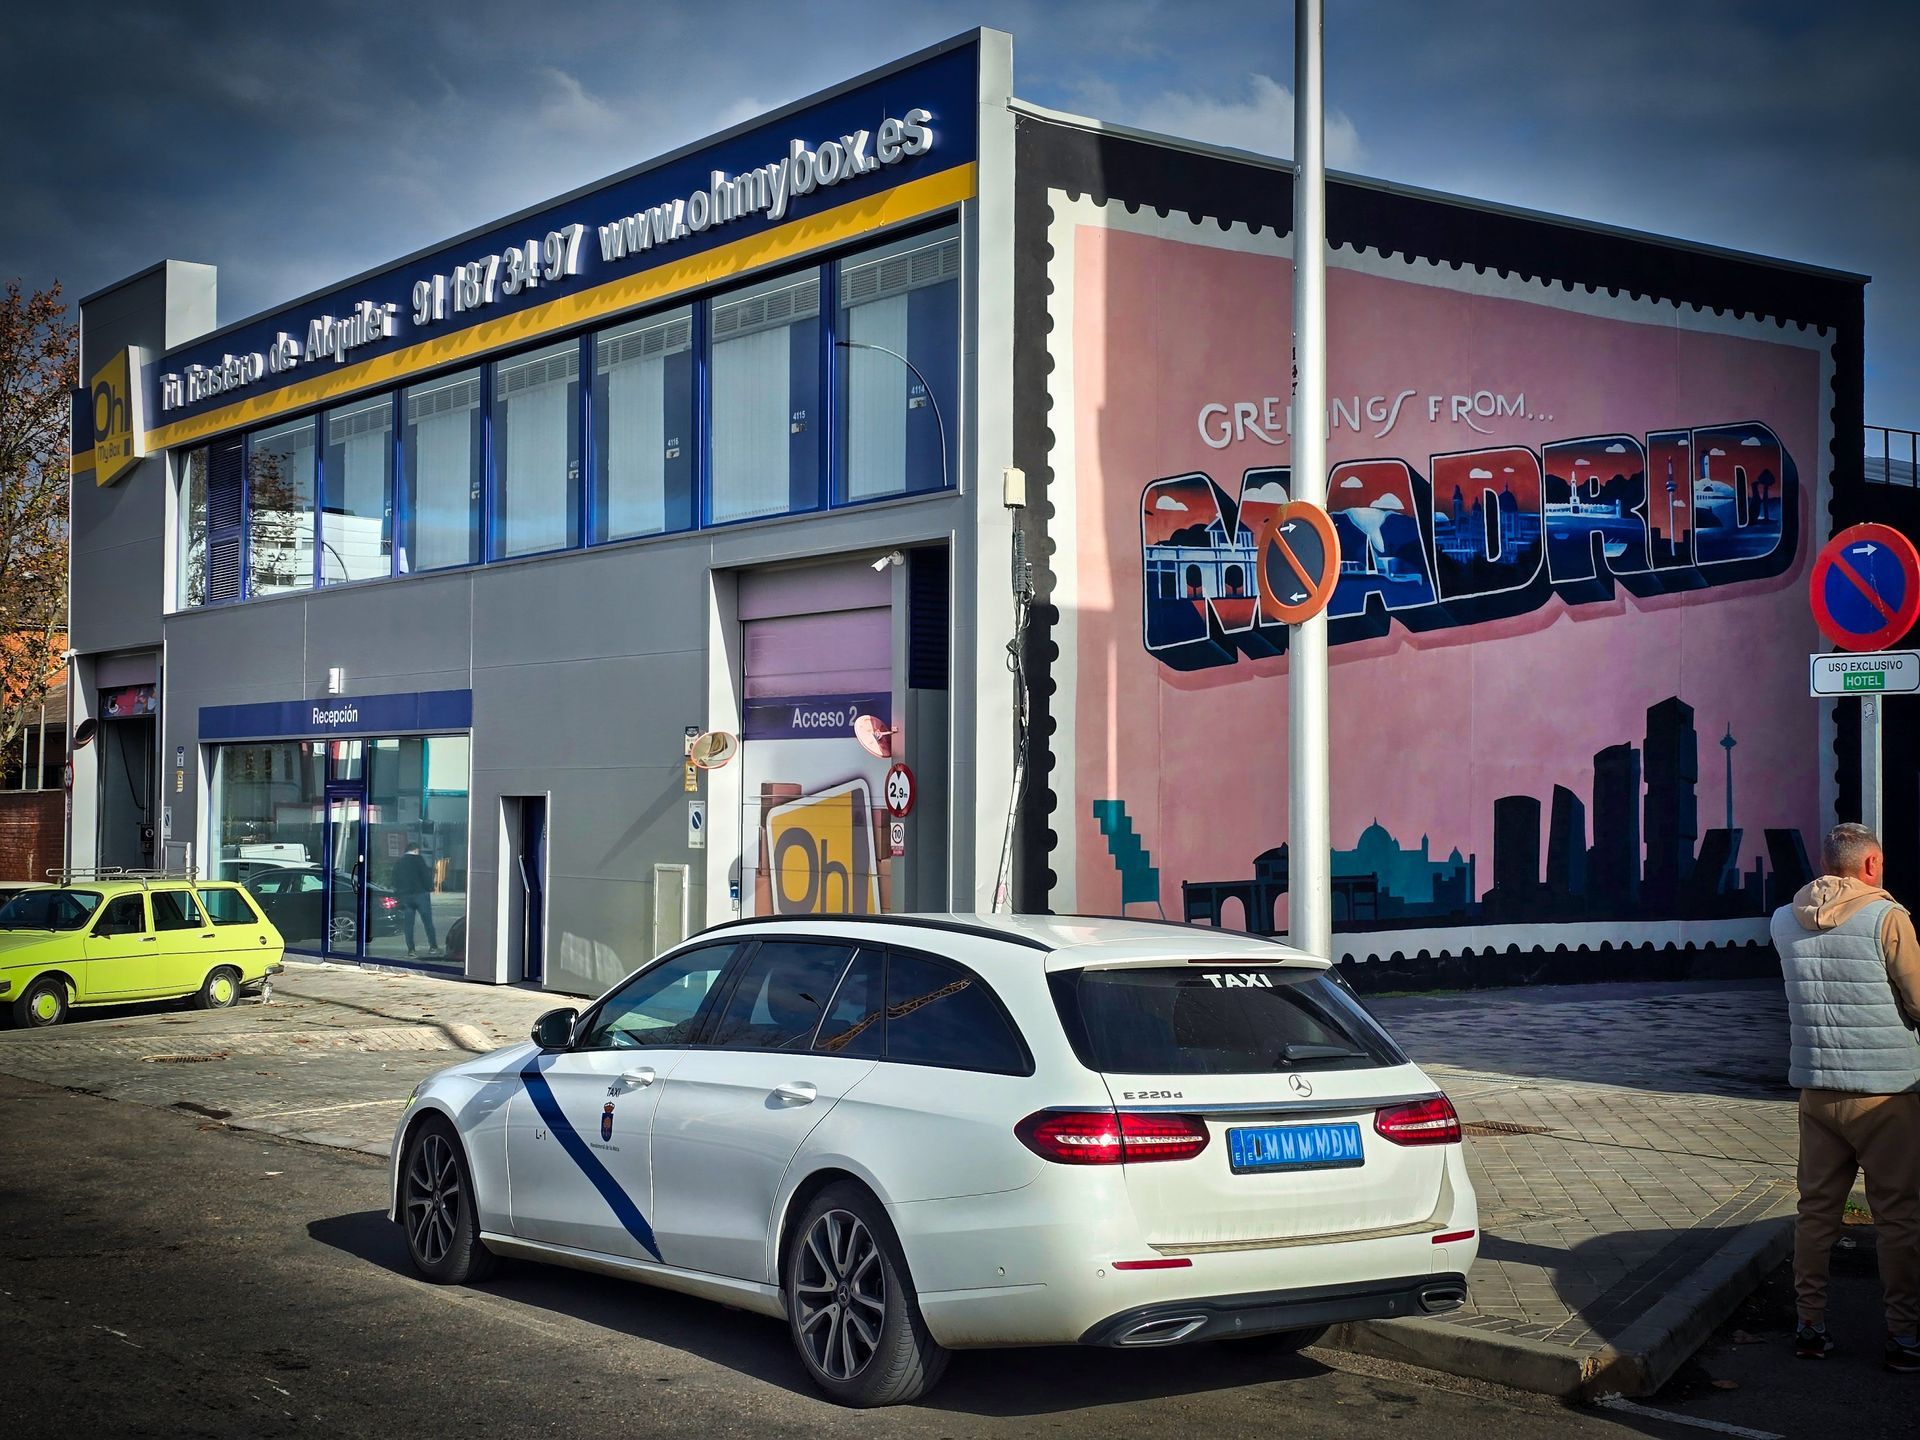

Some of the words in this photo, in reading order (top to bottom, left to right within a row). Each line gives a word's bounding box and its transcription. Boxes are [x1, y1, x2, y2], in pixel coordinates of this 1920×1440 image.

[160, 373, 184, 410] Tu
[184, 354, 264, 402] Trastero
[269, 332, 298, 373] de
[304, 301, 396, 363] Alquiler
[413, 274, 444, 326] 91
[450, 255, 500, 312] 187
[502, 239, 540, 295] 34
[543, 223, 584, 281] 97
[598, 108, 933, 262] www.ohmybox.es
[1197, 390, 1416, 449] GRENGS
[1143, 420, 1799, 670] MADRID
[1828, 662, 1848, 672] USO
[1850, 660, 1903, 671] EXCLUSIVO
[1846, 675, 1882, 687] HOTEL
[313, 704, 358, 727] Recepción
[792, 707, 845, 729] Acceso
[848, 705, 858, 727] 2
[1202, 973, 1274, 989] TAXI
[606, 1087, 621, 1098] TAXI
[1123, 1092, 1135, 1100] E
[535, 1129, 546, 1141] L-1
